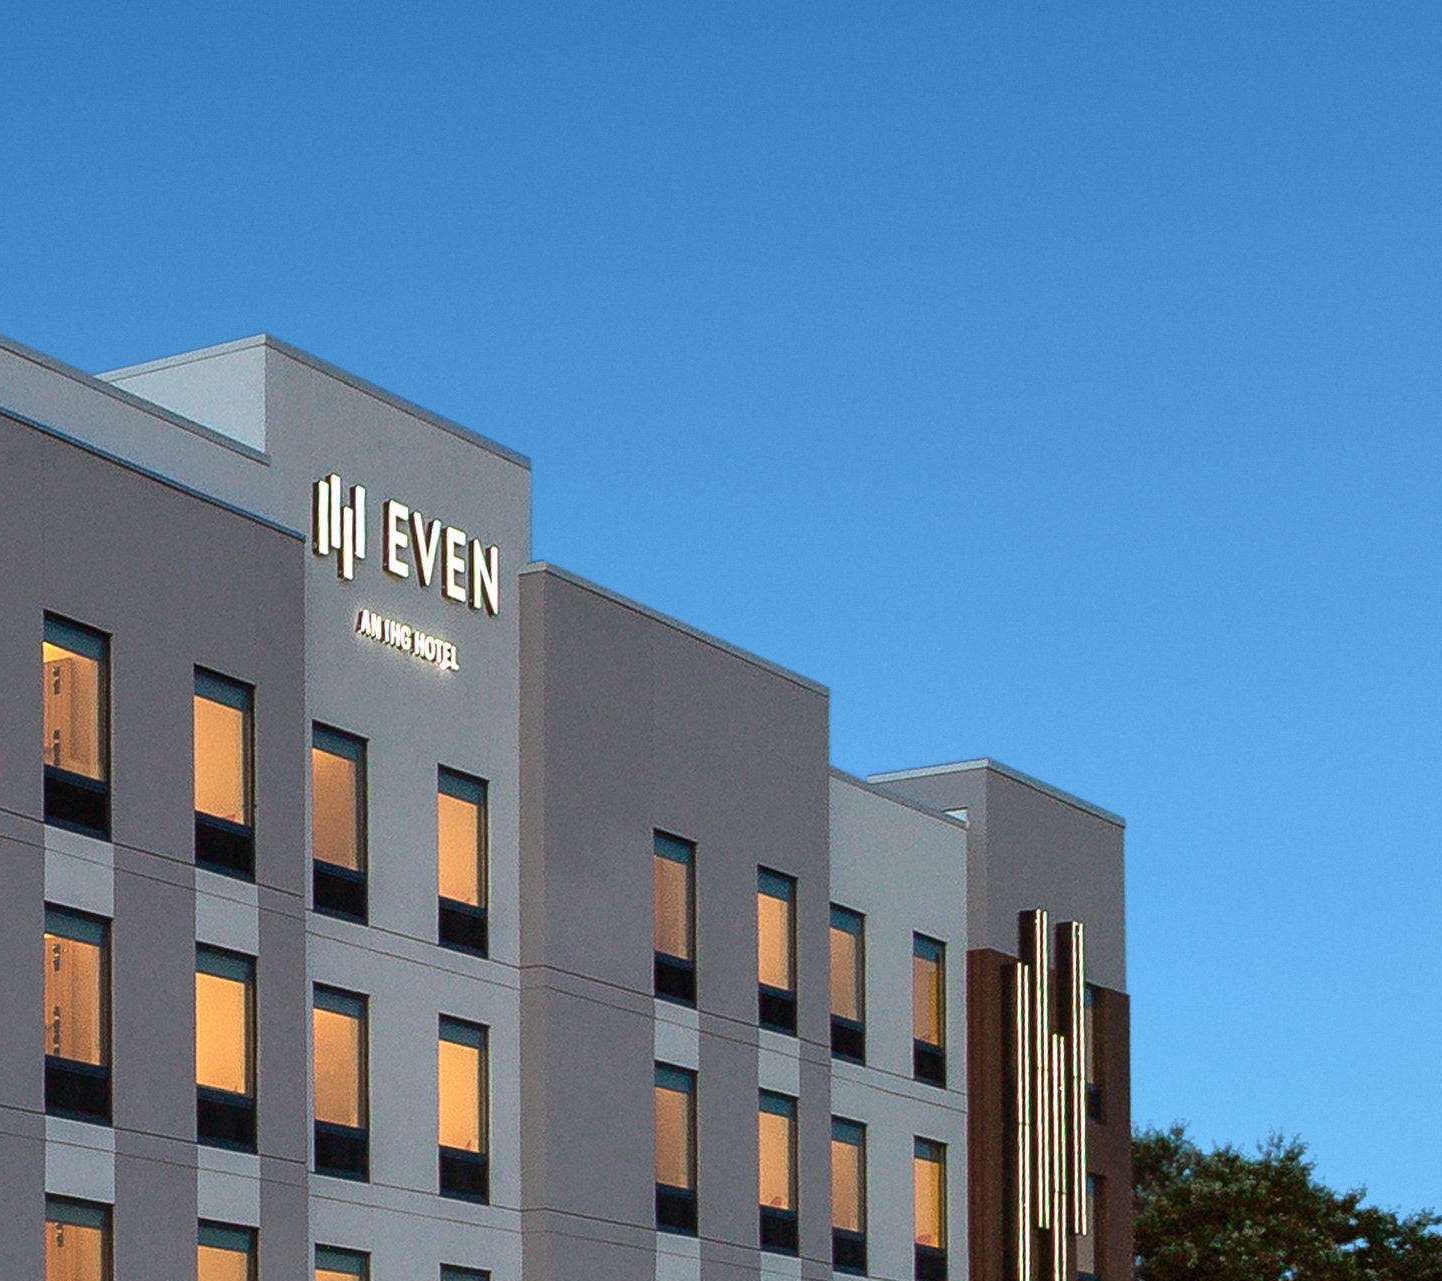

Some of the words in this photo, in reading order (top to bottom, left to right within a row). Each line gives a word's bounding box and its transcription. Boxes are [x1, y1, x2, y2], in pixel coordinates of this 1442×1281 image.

[385, 499, 498, 616] EVEN
[359, 609, 382, 641] AN
[384, 619, 412, 651] IHG
[413, 631, 460, 671] HOTEL
